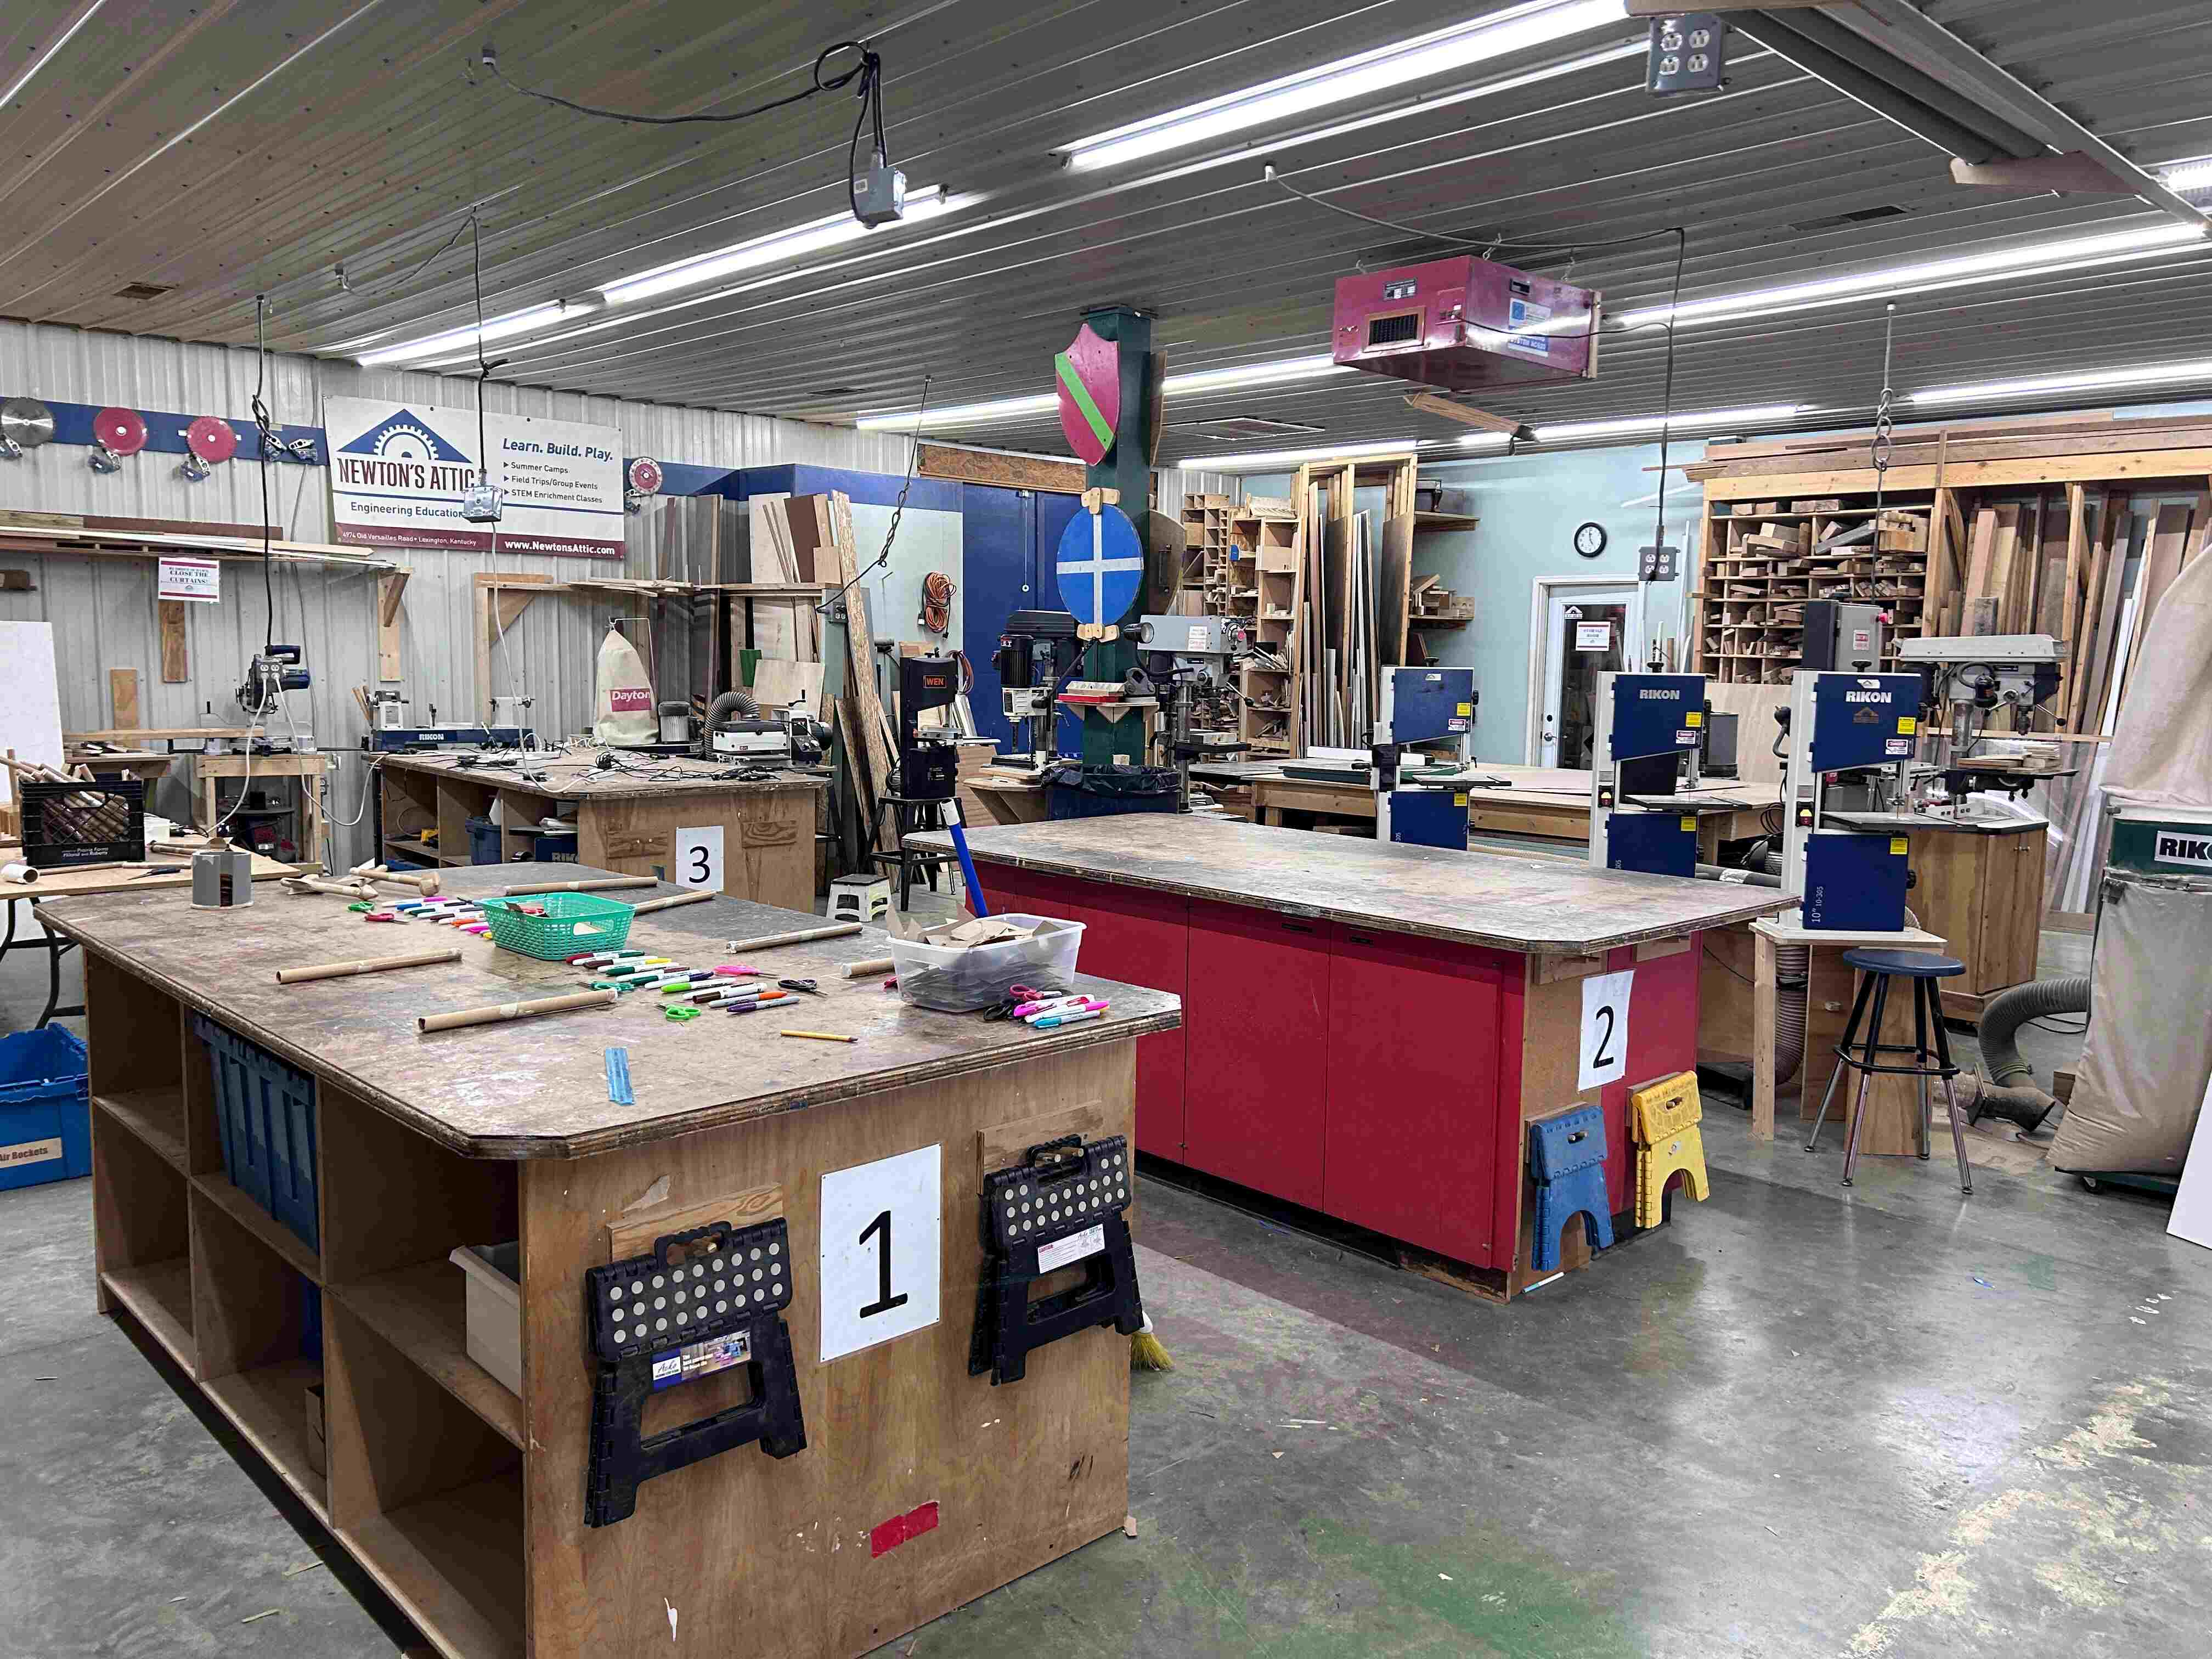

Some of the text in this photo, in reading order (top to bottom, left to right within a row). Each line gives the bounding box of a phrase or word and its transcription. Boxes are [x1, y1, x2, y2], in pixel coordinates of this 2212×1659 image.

[503, 438, 613, 462] Learn. Build. Play.
[337, 458, 475, 492] NEWTON'S ATTIC
[511, 462, 568, 474] Summer Camps
[512, 475, 598, 490] Field Trips/Group Events
[534, 491, 575, 501] Enrichment
[577, 495, 602, 503] Classes
[351, 501, 412, 517] Engineering
[504, 541, 615, 555] www.NewtonsAttic.com
[1639, 689, 1680, 699] RIKON
[1846, 691, 1892, 703] RIKON
[2159, 837, 2212, 861] RIK
[689, 846, 710, 883] 3
[1815, 886, 1824, 906] 10-305
[1593, 1005, 1614, 1069] 2
[859, 1209, 909, 1319] 1
